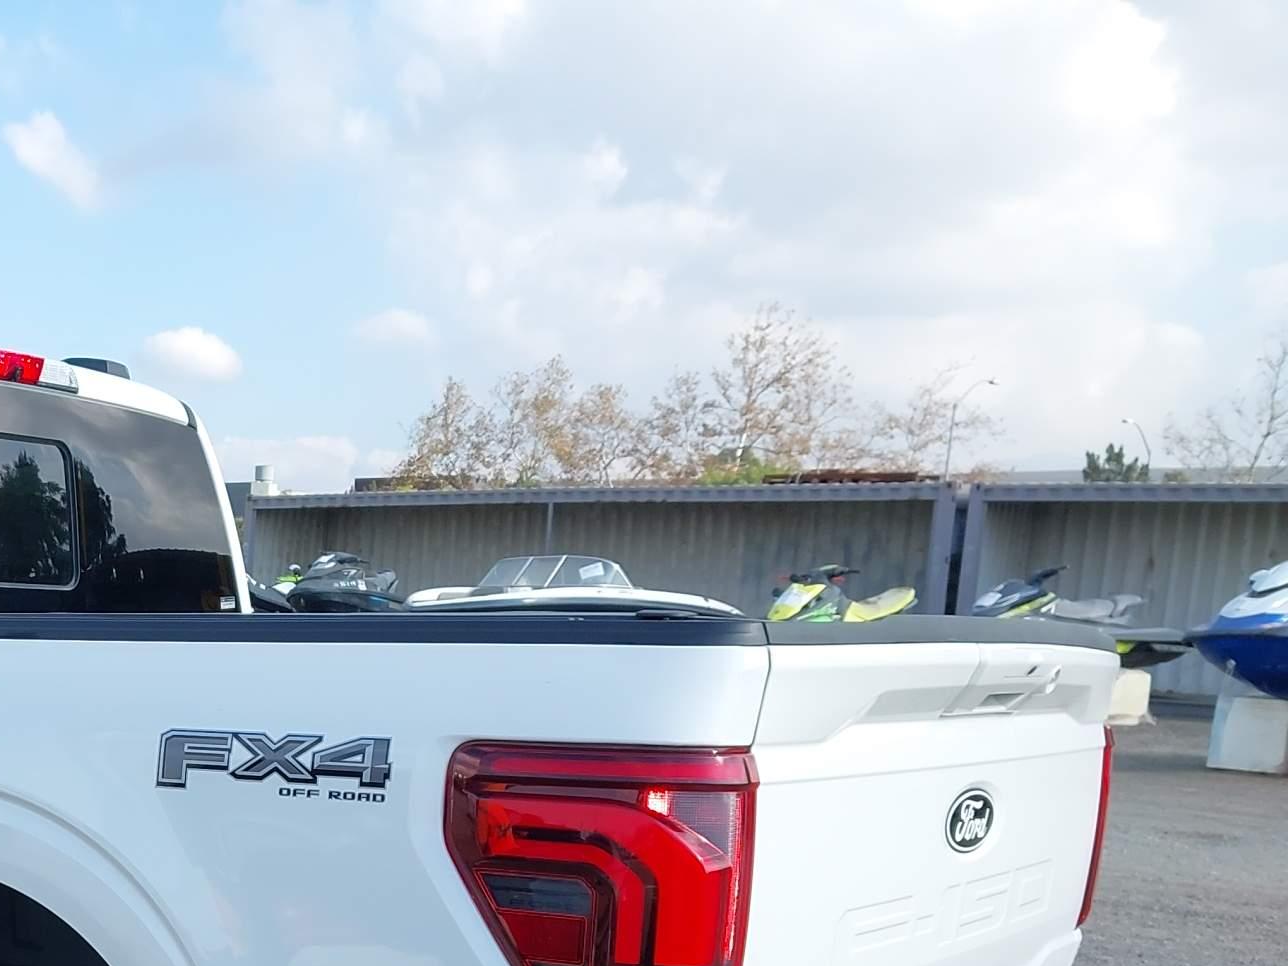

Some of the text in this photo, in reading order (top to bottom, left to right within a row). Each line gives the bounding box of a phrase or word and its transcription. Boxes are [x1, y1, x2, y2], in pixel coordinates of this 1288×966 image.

[156, 729, 391, 788] FX4
[278, 787, 386, 803] OFF ROAD
[954, 799, 990, 843] Ford
